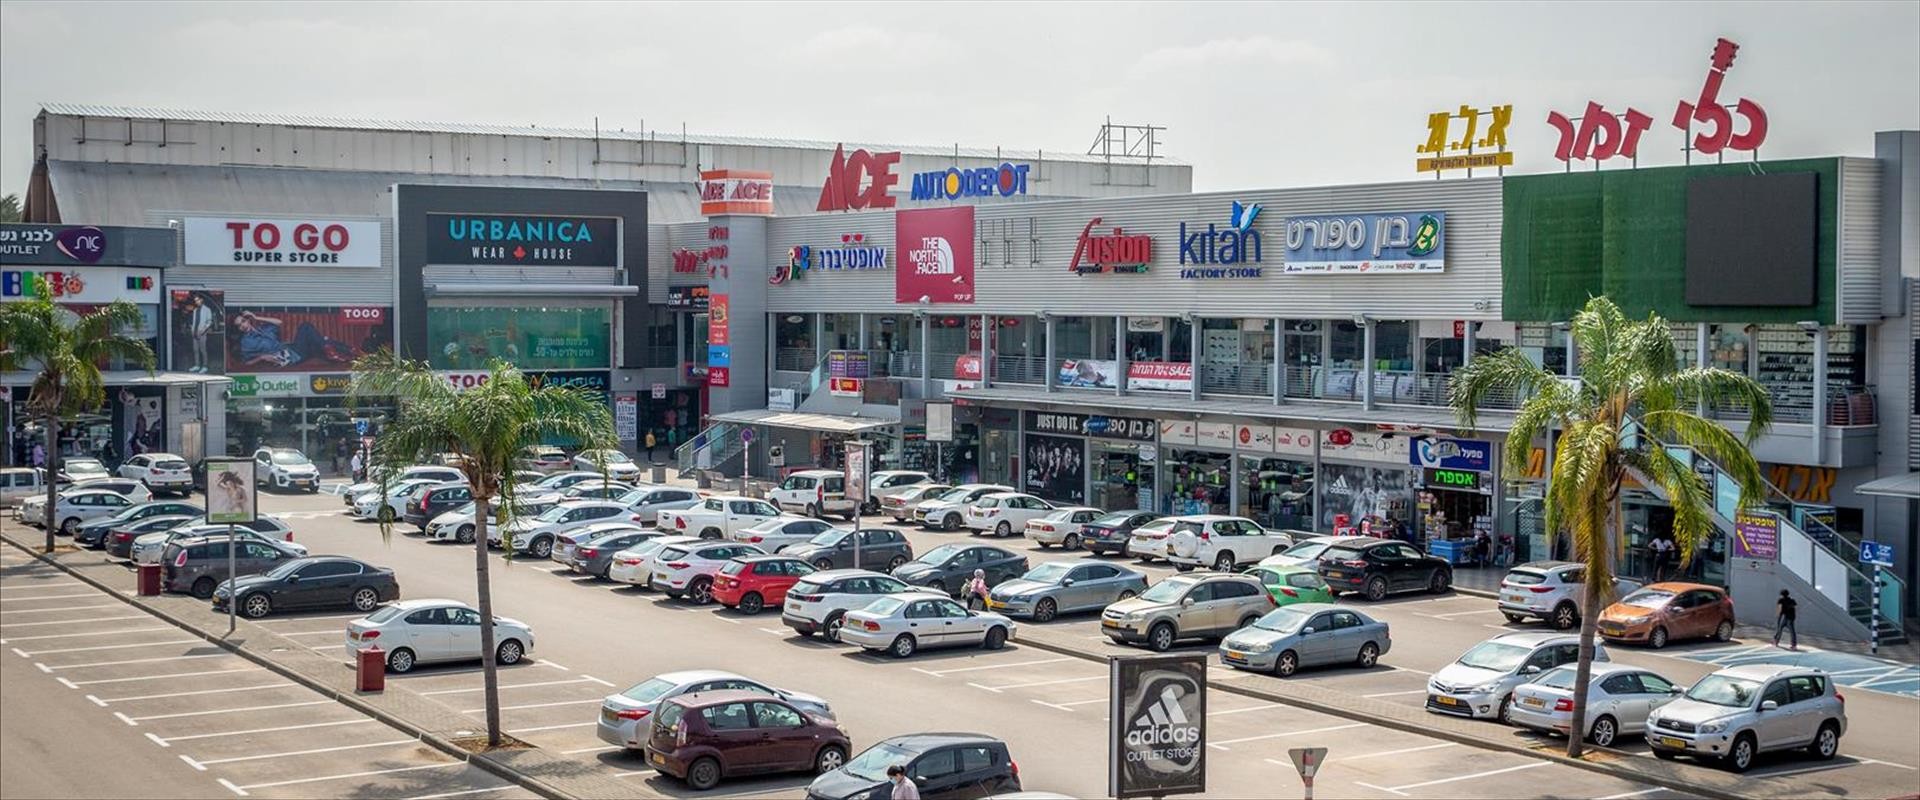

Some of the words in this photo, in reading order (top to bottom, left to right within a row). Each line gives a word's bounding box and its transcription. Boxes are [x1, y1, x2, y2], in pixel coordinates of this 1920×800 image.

[1547, 101, 1653, 161] זמר
[816, 142, 901, 212] ACE
[911, 162, 1030, 201] AUTODEPOT
[702, 181, 726, 201] ACE
[730, 180, 771, 200] ACE
[0, 230, 17, 242] נש
[226, 222, 280, 250] TO
[293, 223, 350, 251] GO
[450, 219, 592, 242] URBANICA
[1286, 217, 1366, 251] ספורט
[1373, 216, 1410, 258] בון
[922, 237, 938, 249] THE
[1068, 217, 1152, 272] fusion
[1180, 222, 1262, 265] kitan
[234, 250, 282, 263] SUPER
[290, 251, 339, 264] STORE
[472, 246, 505, 259] WEAR
[534, 248, 572, 260] HOUSE
[909, 249, 938, 263] NORTH
[1180, 267, 1226, 279] FACTORY
[1229, 267, 1263, 278] STORE
[344, 309, 380, 319] TOGO
[1168, 365, 1192, 377] SALE
[262, 379, 298, 392] Outlet
[450, 374, 490, 389] TOG
[1037, 414, 1055, 429] JUST
[1057, 415, 1068, 430] DO
[1126, 724, 1200, 746] adidas
[1126, 749, 1166, 762] OUTLET
[1165, 747, 1199, 759] STORE
